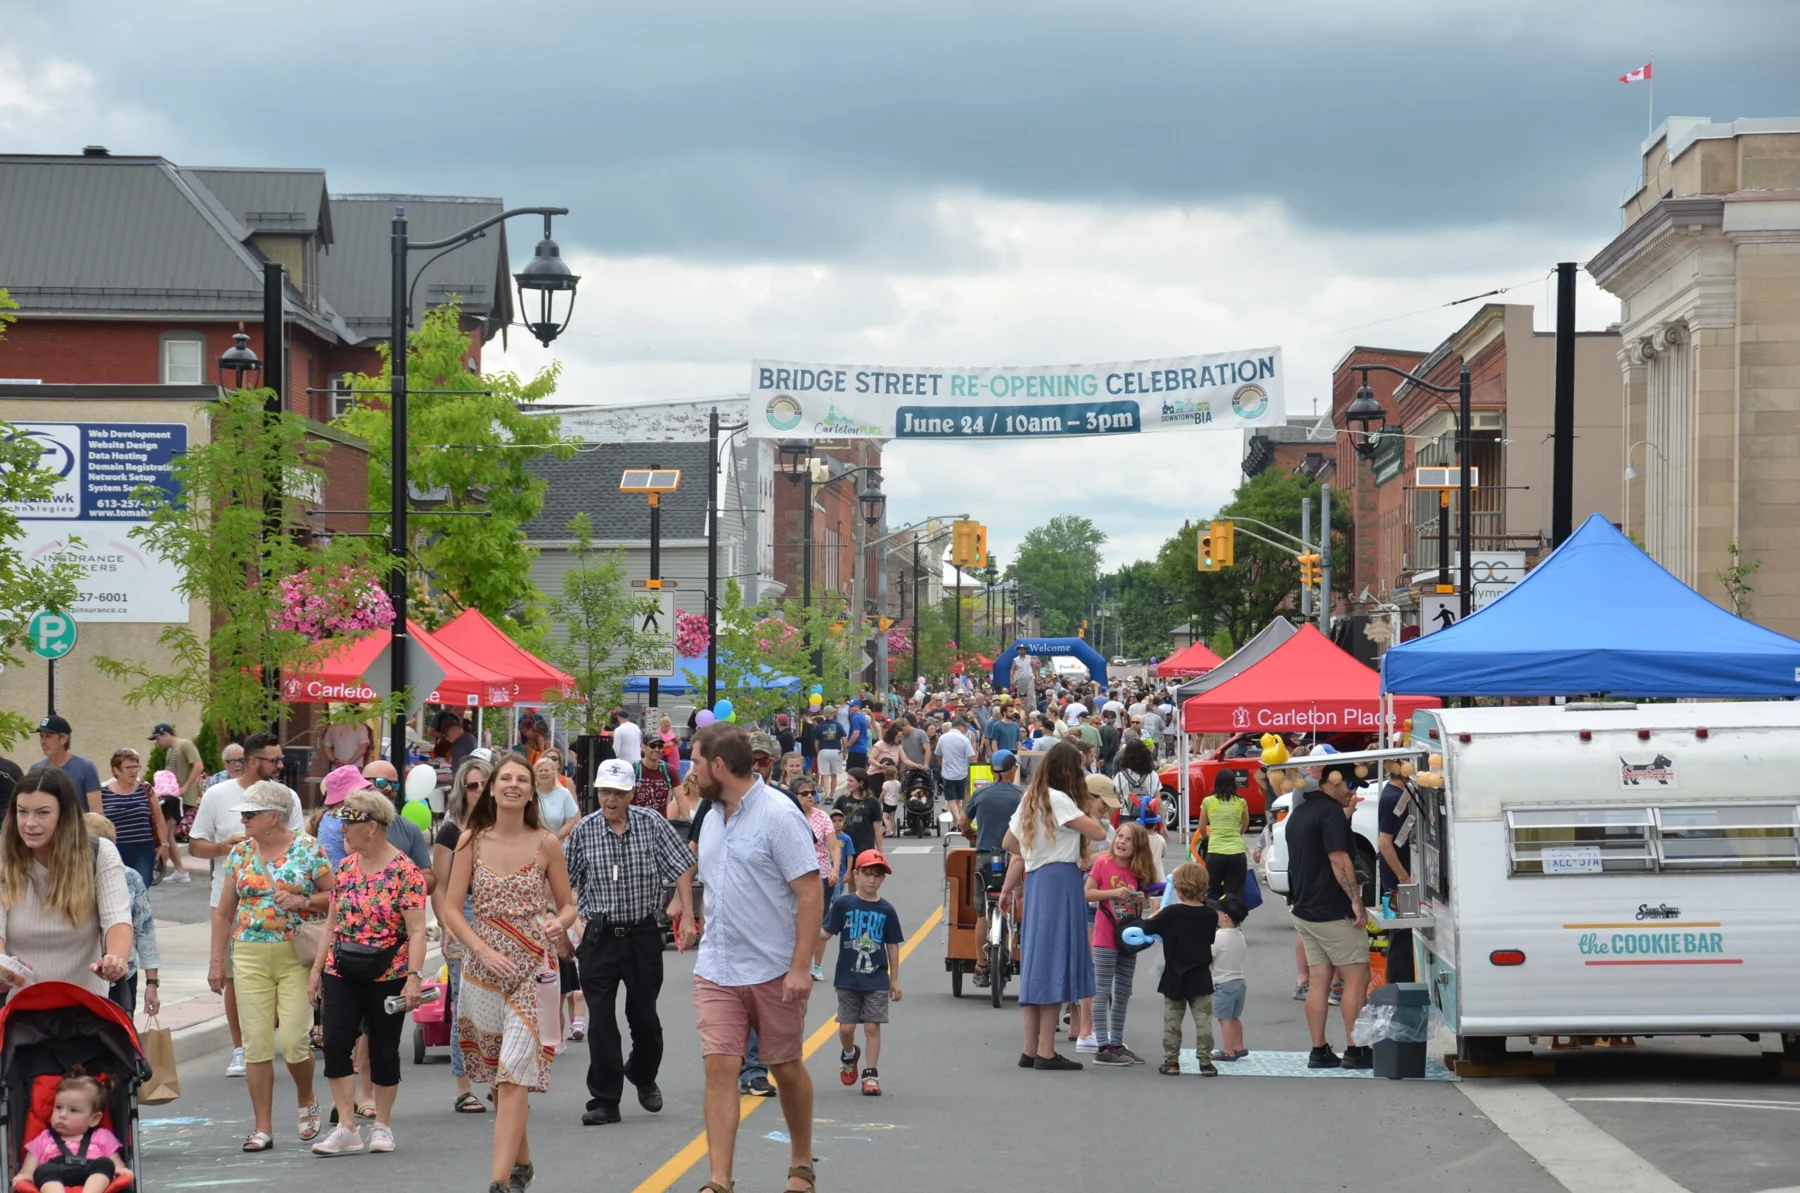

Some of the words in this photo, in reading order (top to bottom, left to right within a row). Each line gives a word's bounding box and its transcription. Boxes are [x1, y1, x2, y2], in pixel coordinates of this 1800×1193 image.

[759, 367, 847, 392] BRIDGE
[855, 371, 943, 396] STREET
[950, 373, 1098, 398] RE-OPENING
[1105, 356, 1275, 395] CELEBRATION
[903, 413, 955, 433] June
[961, 415, 985, 434] 24
[1005, 414, 1062, 433] 10am
[1086, 411, 1134, 433] 3pm
[1161, 414, 1194, 423] DOWNTOWN
[1194, 410, 1213, 425] BIA
[88, 430, 109, 439] Web
[110, 430, 171, 439] Development
[814, 422, 860, 436] Carleton
[88, 441, 124, 450] Website
[126, 441, 158, 450] Design
[88, 452, 109, 460] Data
[112, 452, 148, 462] Hosting
[88, 463, 123, 471] Domain
[88, 473, 127, 482] Network
[129, 473, 156, 483] Setup
[88, 484, 121, 493] System
[38, 615, 67, 649] P
[1029, 644, 1071, 653] Welcome
[307, 681, 376, 699] Carleto
[1257, 709, 1337, 726] Carleton
[1344, 709, 1397, 725] Place
[1578, 932, 1609, 955] the
[1611, 933, 1681, 954] COOKIE
[1684, 933, 1724, 953] BAR
